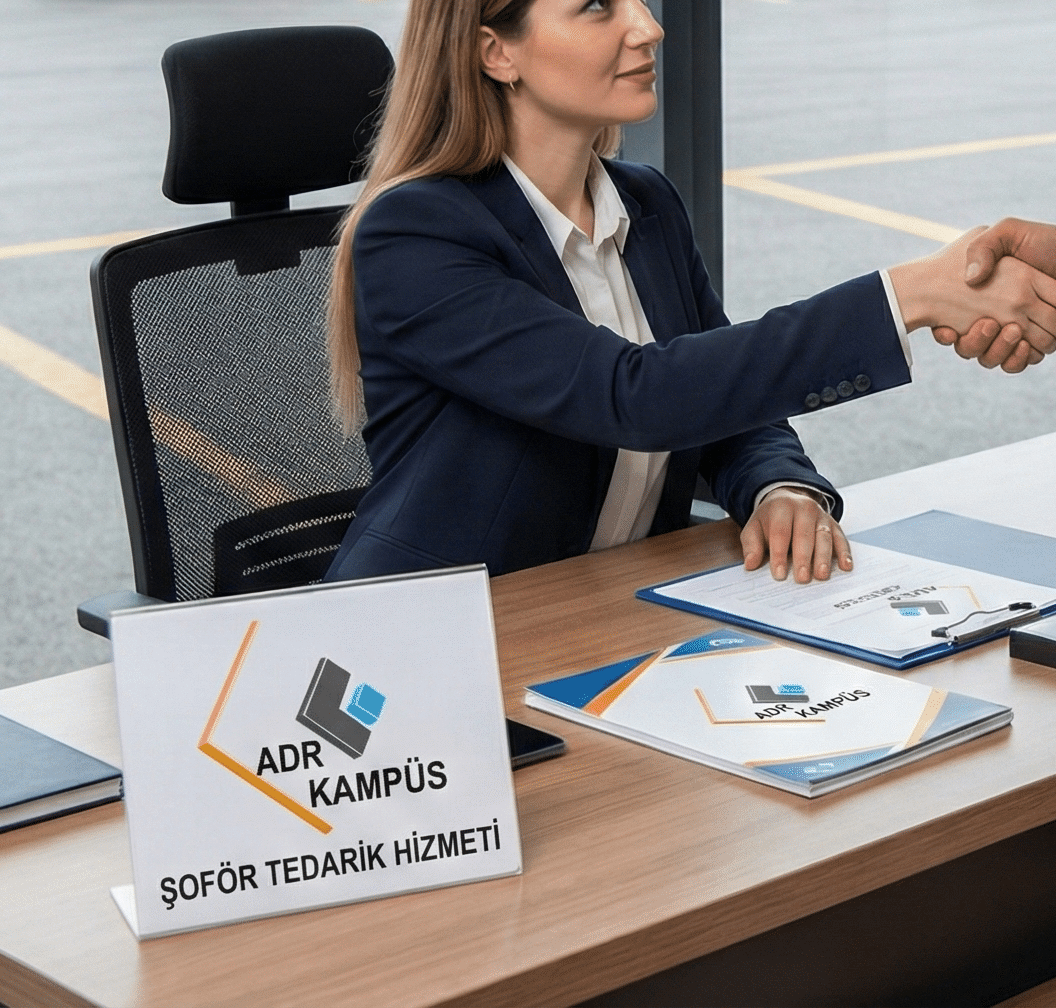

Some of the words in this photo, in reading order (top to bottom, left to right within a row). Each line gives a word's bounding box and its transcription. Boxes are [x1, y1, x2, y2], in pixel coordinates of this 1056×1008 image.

[755, 704, 793, 719] ADR
[794, 689, 871, 718] KAMPÜS
[257, 741, 324, 776] ADR
[309, 757, 448, 808] KAMPÜS
[161, 862, 258, 910] ŞOFÖR
[265, 840, 386, 885] TEDARİK
[394, 818, 500, 865] HİZMETİ
